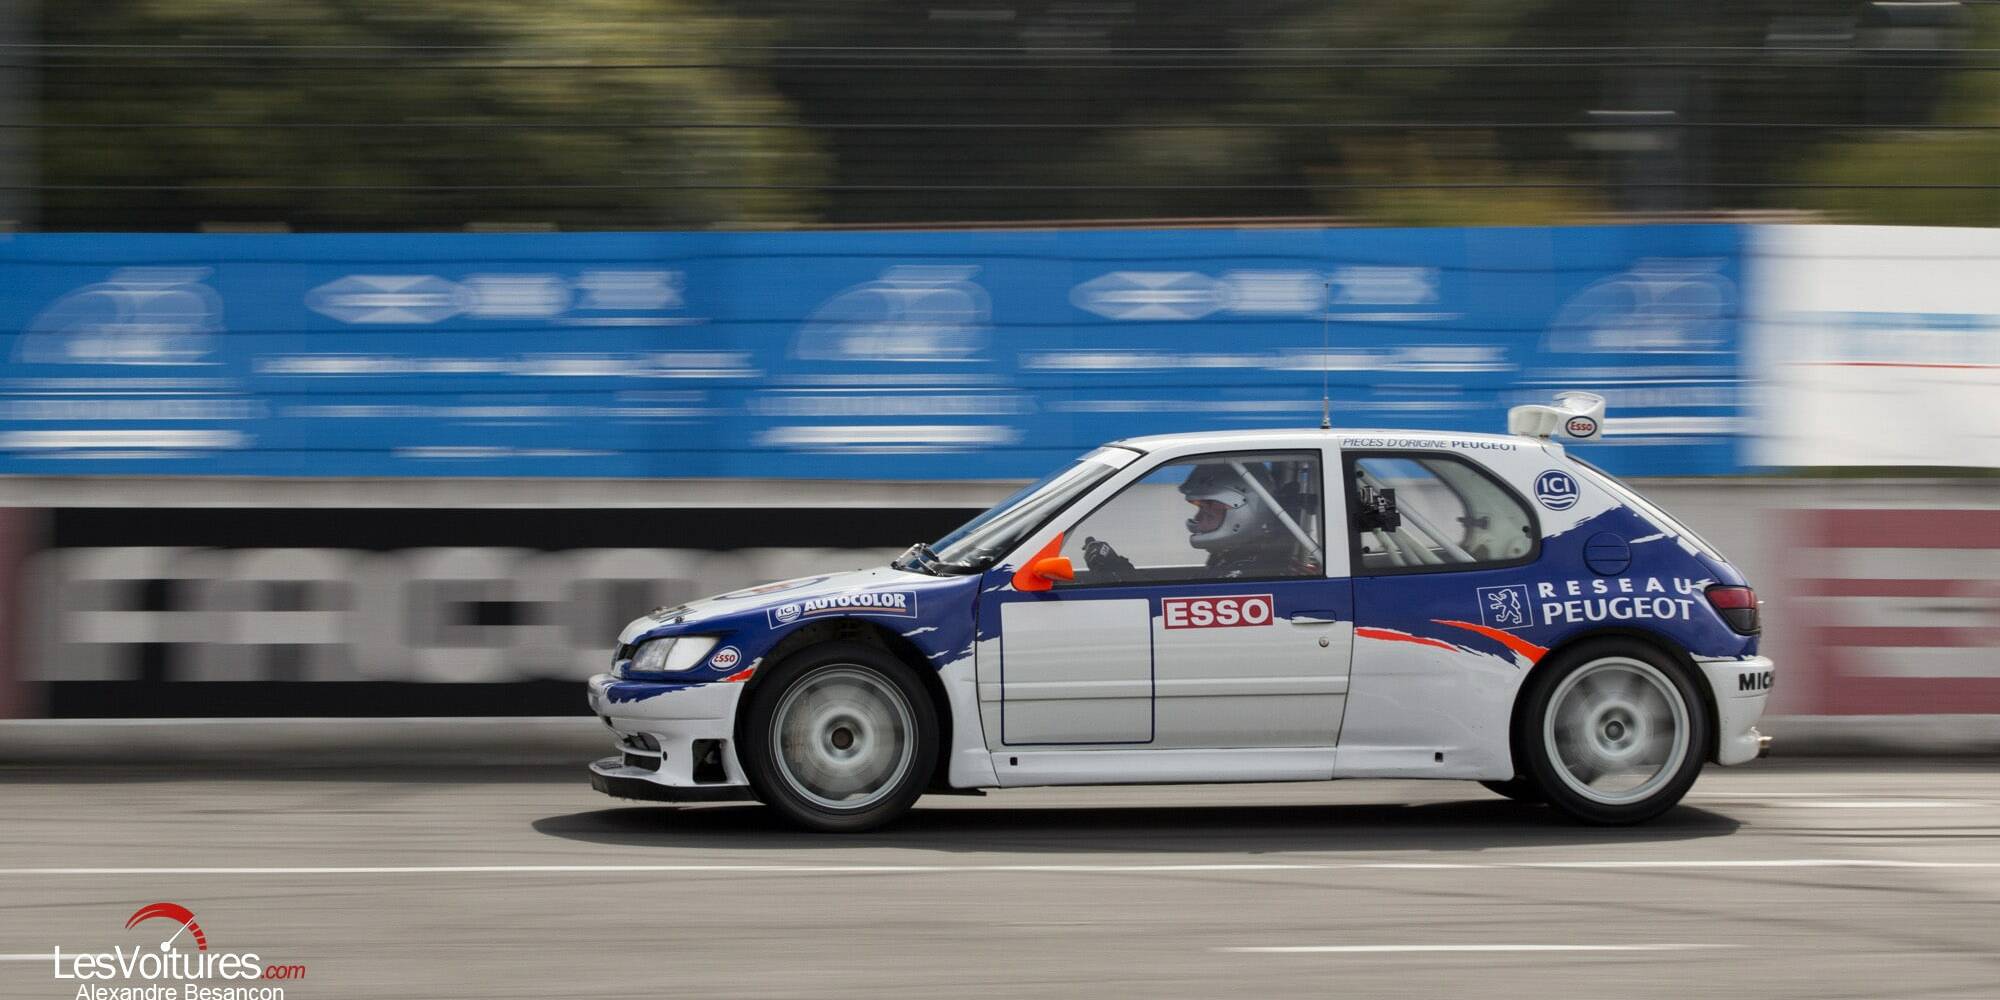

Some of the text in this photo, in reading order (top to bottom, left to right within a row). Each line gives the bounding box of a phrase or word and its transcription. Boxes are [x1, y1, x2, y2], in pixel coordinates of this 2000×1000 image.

[1343, 438, 1384, 448] PIECES
[1451, 440, 1517, 452] PEUGEOT
[1542, 476, 1570, 494] ICI
[1537, 577, 1692, 598] RESEAU
[779, 592, 907, 616] ICI AUTOCOLOR
[1167, 599, 1270, 627] ESSO
[1542, 597, 1694, 625] PEUGEOT
